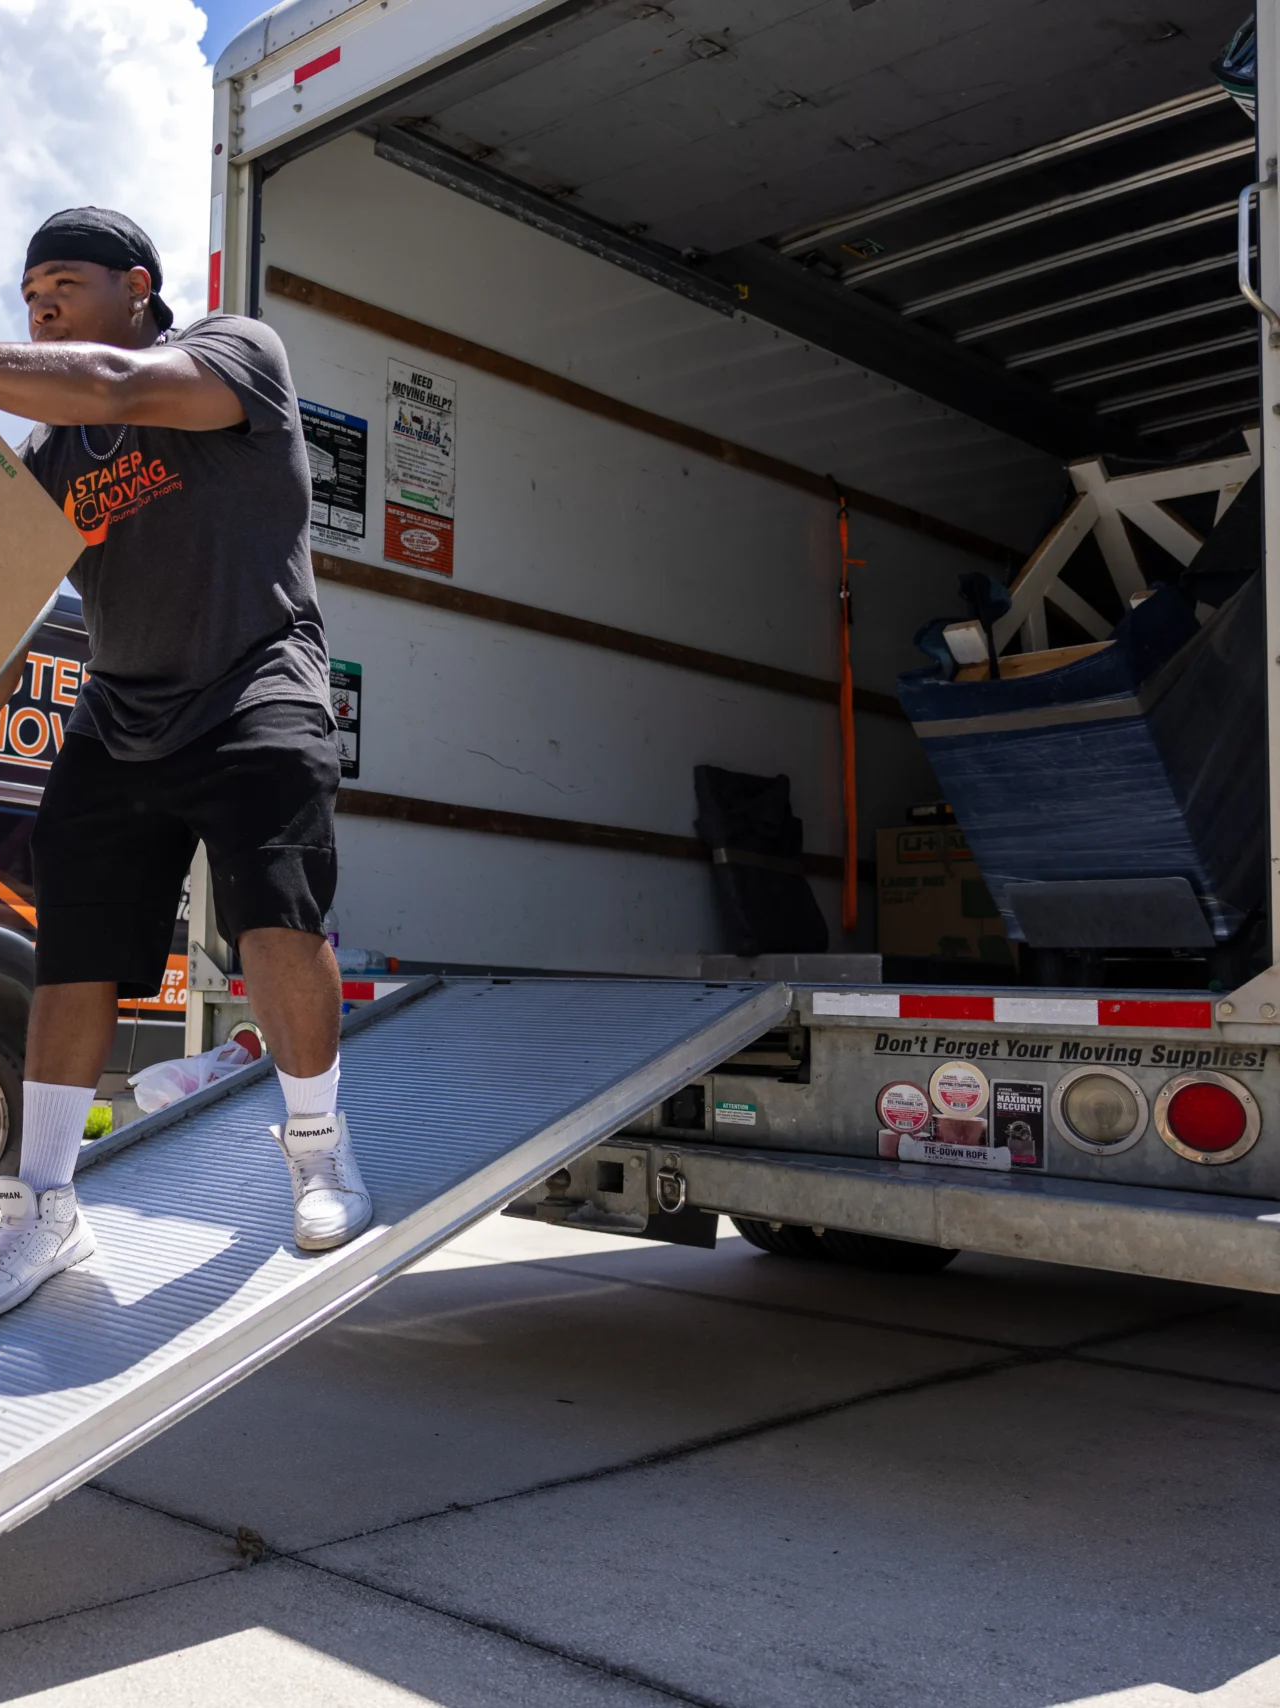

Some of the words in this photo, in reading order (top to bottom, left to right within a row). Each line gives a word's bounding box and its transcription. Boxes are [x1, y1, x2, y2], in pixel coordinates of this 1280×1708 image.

[411, 372, 433, 390] NEED
[392, 381, 426, 402] MOVING
[427, 393, 453, 410] HELP?
[387, 507, 405, 517] NEED
[161, 968, 184, 986] TE?
[875, 1033, 928, 1053] Don't
[933, 1036, 1000, 1060] Forget
[1006, 1040, 1053, 1059] Your
[1059, 1041, 1142, 1067] Moving
[1150, 1044, 1267, 1070] Supplies!
[996, 1095, 1042, 1105] MAXIMUM
[996, 1103, 1042, 1113] SECURITY
[923, 1146, 964, 1157] TIE-DOWN
[966, 1150, 988, 1160] ROPE
